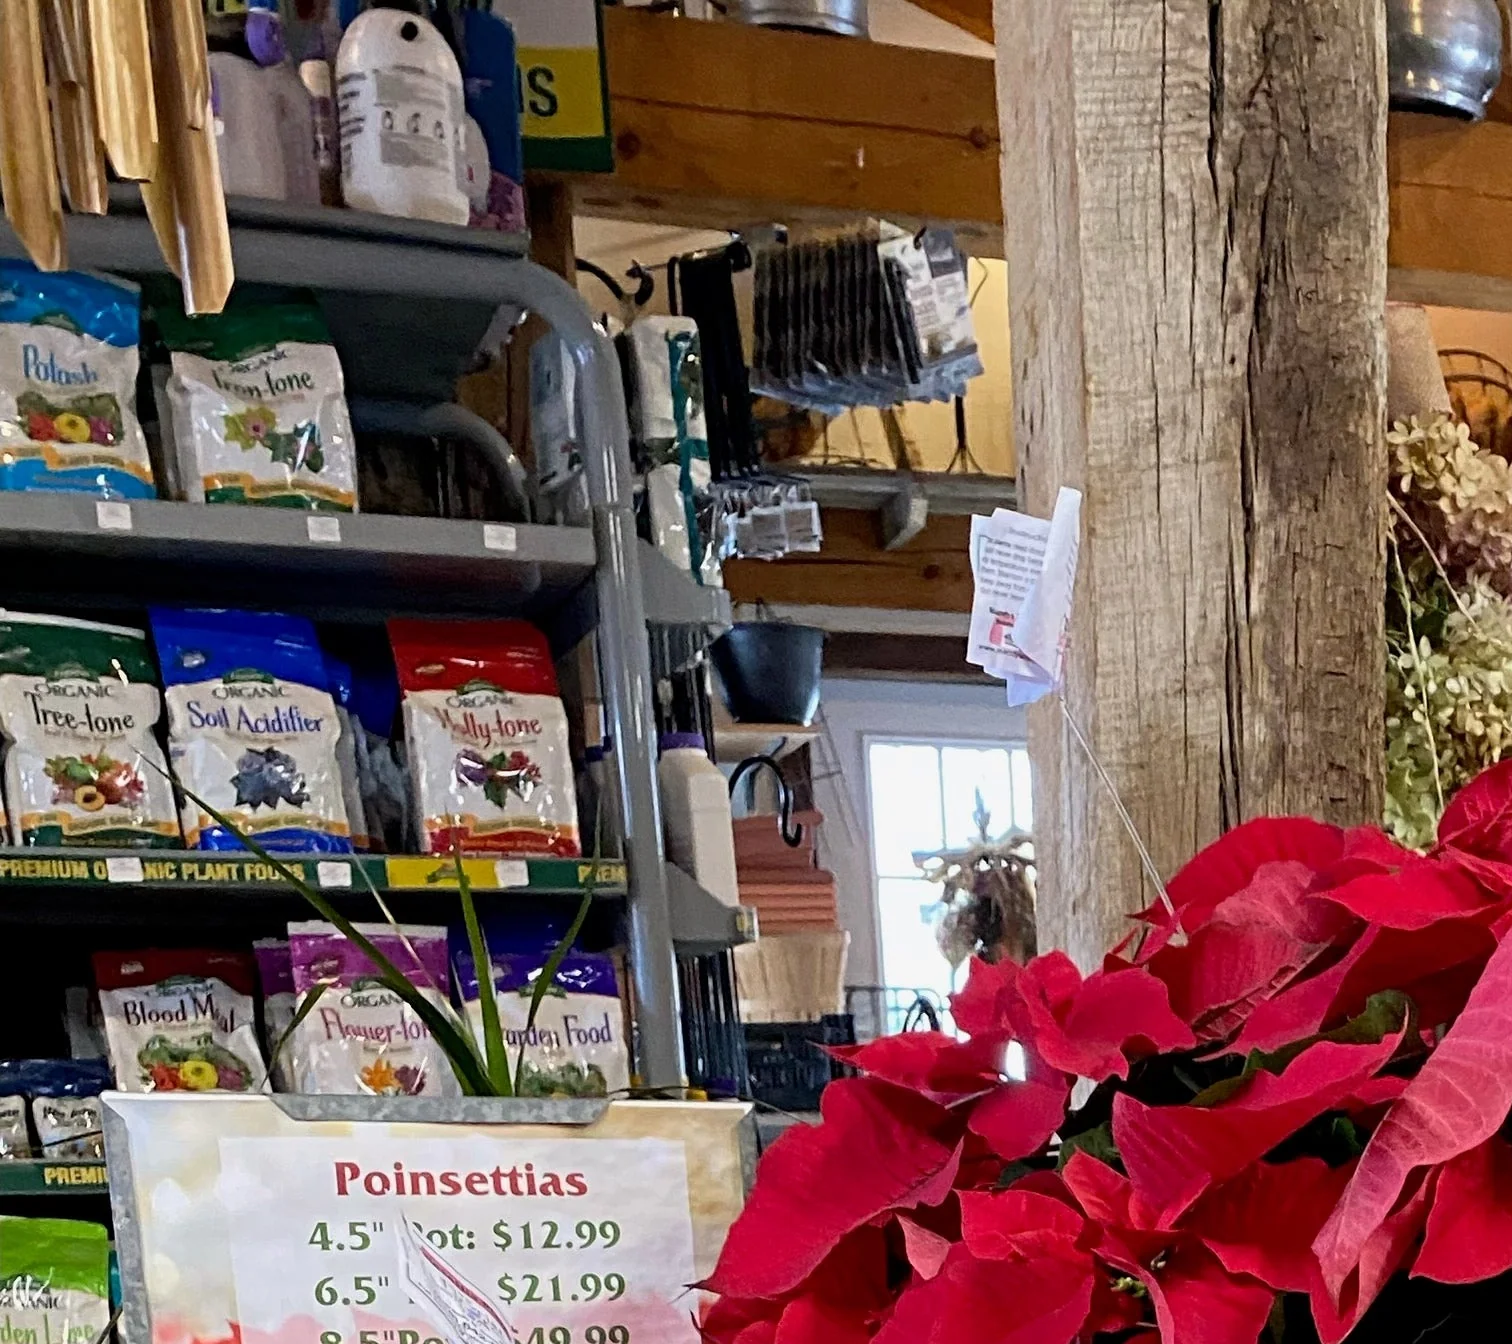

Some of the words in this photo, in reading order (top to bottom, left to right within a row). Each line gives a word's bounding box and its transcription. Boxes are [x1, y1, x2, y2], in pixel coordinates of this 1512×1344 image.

[22, 343, 98, 386] Potash
[33, 682, 114, 700] ORGANIC
[211, 685, 287, 700] ORGANIC
[23, 689, 135, 733] Tree-tone
[186, 701, 229, 730] Soil
[237, 702, 323, 734] Acidifier
[0, 859, 89, 879] PREMIUM
[93, 860, 177, 880] ONIC
[181, 862, 239, 881] PLANT
[123, 1000, 187, 1027] Blood
[564, 1012, 613, 1046] Food
[44, 1166, 108, 1185] PREMI
[333, 1160, 589, 1197] Poinsettias
[307, 1220, 385, 1252] 4.5"
[492, 1218, 622, 1252] $12.99
[313, 1274, 391, 1307] 6.5"
[496, 1271, 627, 1306] $21.99
